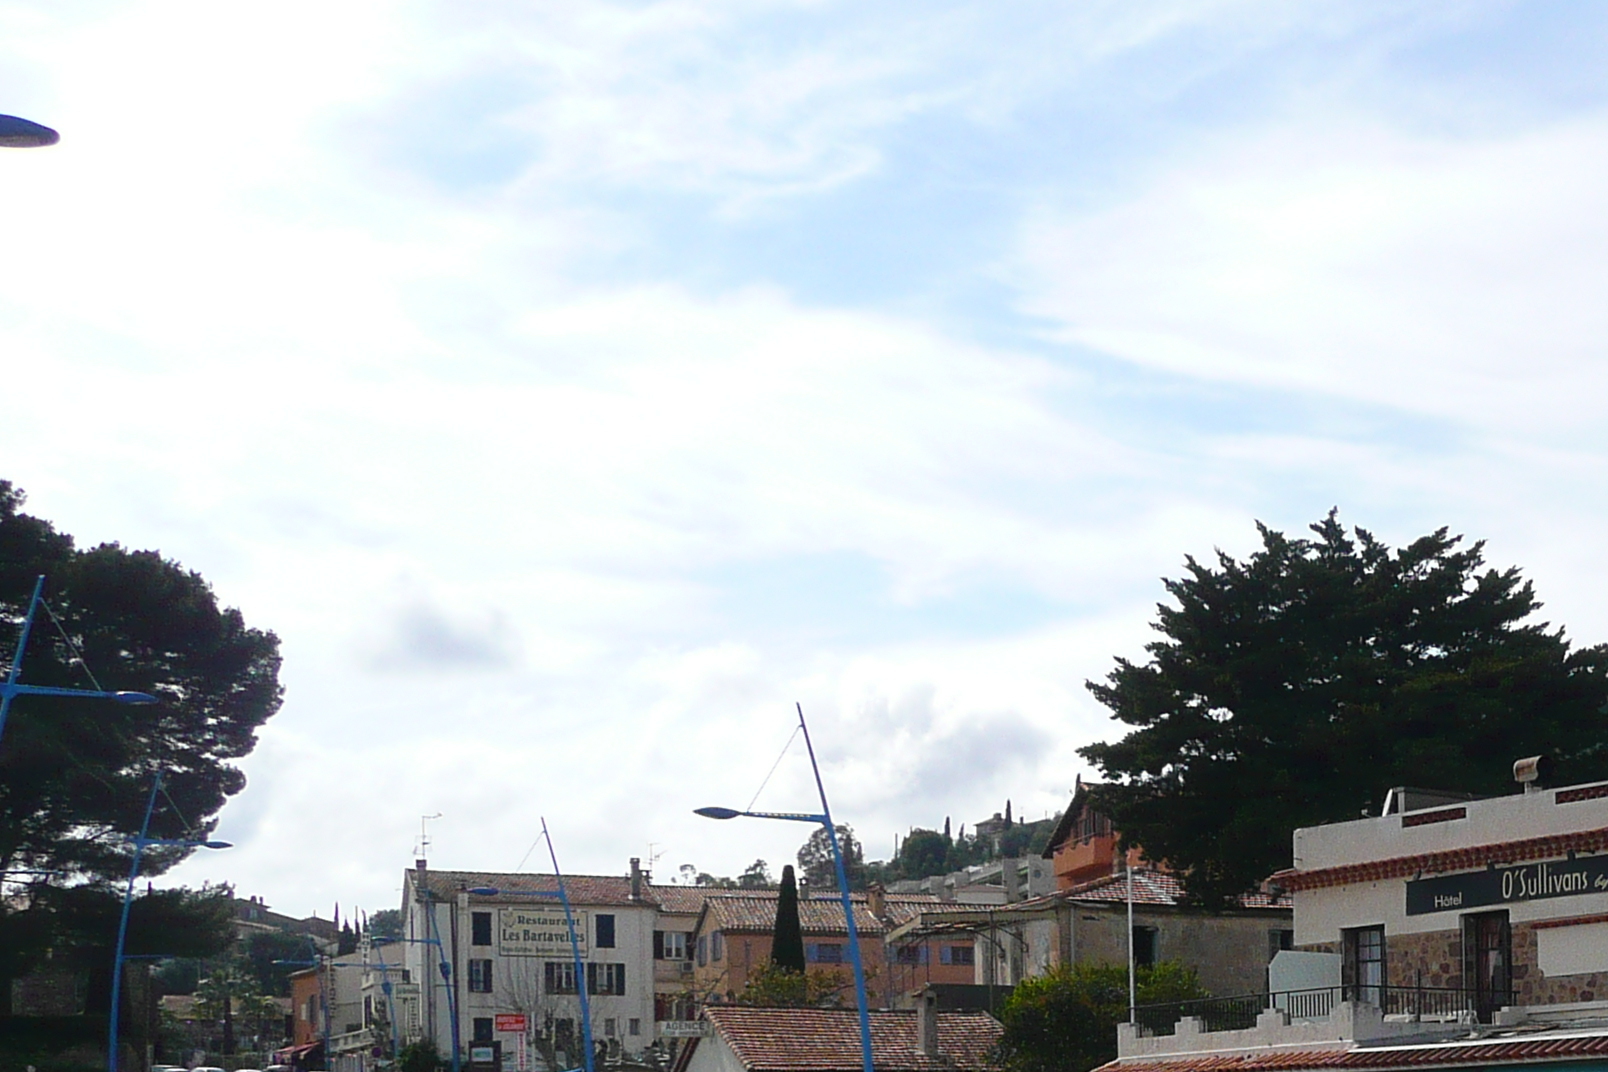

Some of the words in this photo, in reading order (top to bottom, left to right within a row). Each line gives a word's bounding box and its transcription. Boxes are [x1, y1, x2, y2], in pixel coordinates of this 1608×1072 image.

[1434, 892, 1462, 908] Hôtel
[1502, 863, 1588, 899] O'Sullivans
[502, 929, 520, 941] Les
[523, 929, 585, 942] Bartaveles
[665, 1022, 705, 1030] AGENCE
